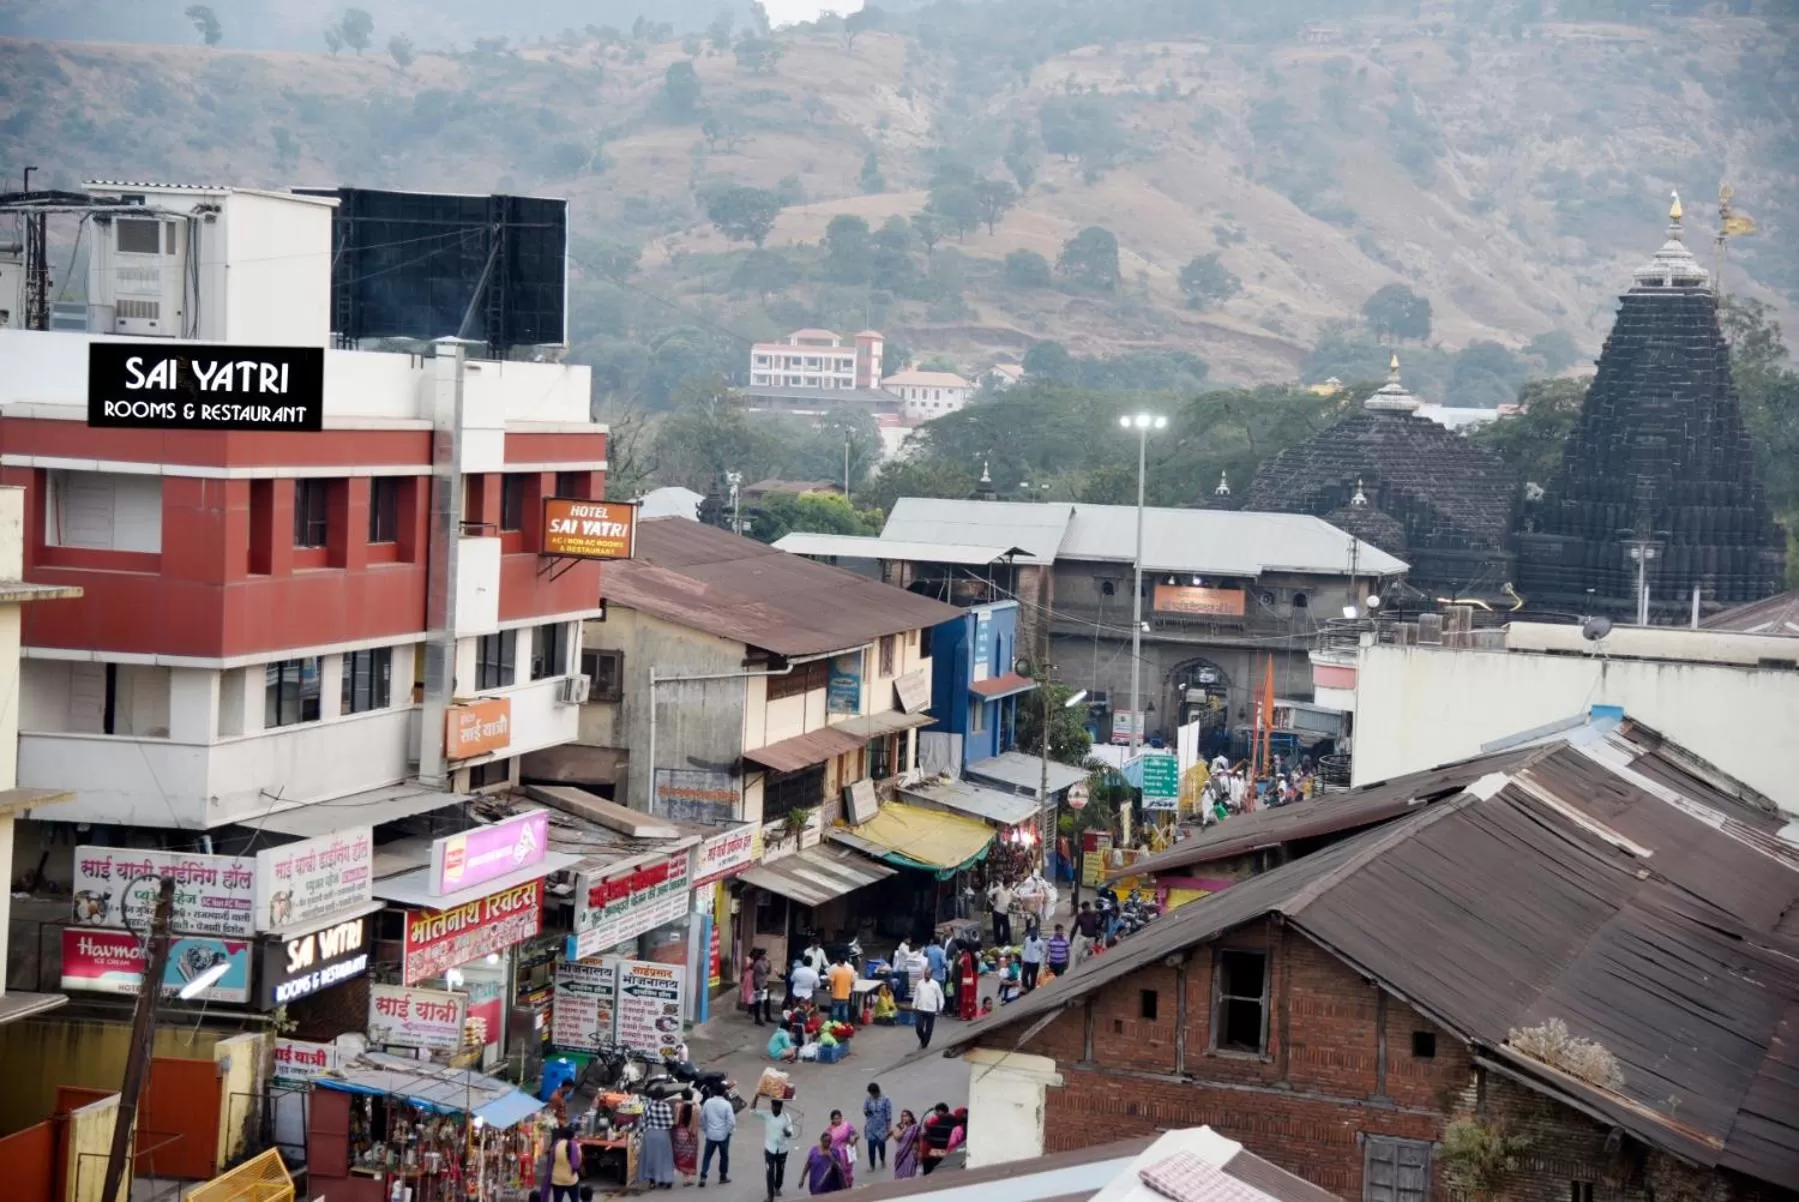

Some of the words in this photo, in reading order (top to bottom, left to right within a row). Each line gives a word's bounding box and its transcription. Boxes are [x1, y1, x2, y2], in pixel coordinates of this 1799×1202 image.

[125, 356, 177, 390] SAI
[191, 360, 289, 394] YATRI
[104, 400, 176, 419] ROOMS
[182, 403, 195, 419] &
[201, 404, 307, 423] RESTAURANT
[570, 505, 609, 519] HOTEL
[549, 519, 578, 534] SAI
[582, 521, 628, 537] YATRI
[80, 855, 112, 882] साई
[222, 863, 253, 889] हॉल
[76, 936, 149, 959] Havmo
[286, 935, 315, 974] SAI
[319, 919, 363, 960] YATRI
[118, 984, 141, 994] HOTE
[623, 973, 679, 989] भोजनालय
[376, 993, 411, 1020] साई
[415, 999, 458, 1023] यात्री
[275, 1044, 292, 1064] ाई
